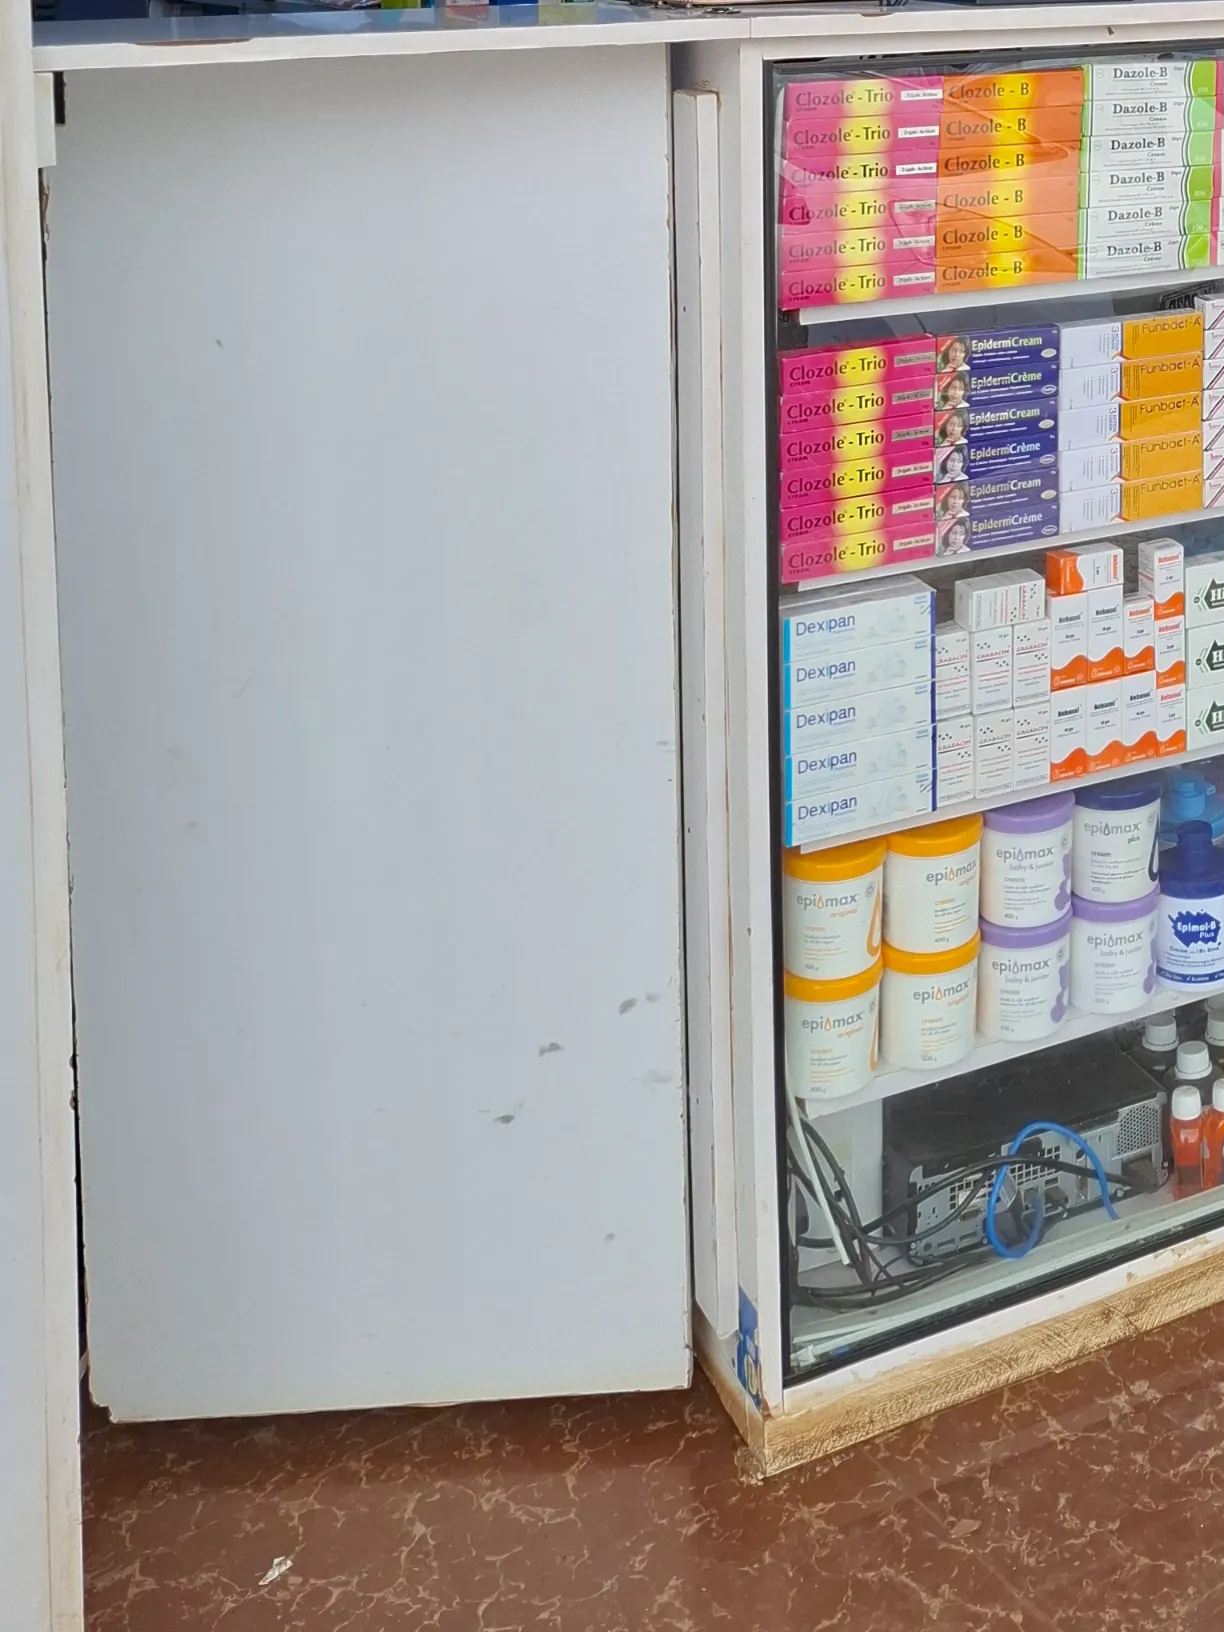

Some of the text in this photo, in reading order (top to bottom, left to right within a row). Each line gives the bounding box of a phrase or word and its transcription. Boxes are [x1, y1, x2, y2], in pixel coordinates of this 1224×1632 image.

[1113, 66, 1168, 79] Dazole-B
[795, 85, 893, 107] Clozole Trio
[946, 117, 1027, 136] Clozole B
[789, 358, 887, 381] Clozole Trio
[795, 615, 856, 636] Dexipan
[1200, 931, 1215, 939] Plus
